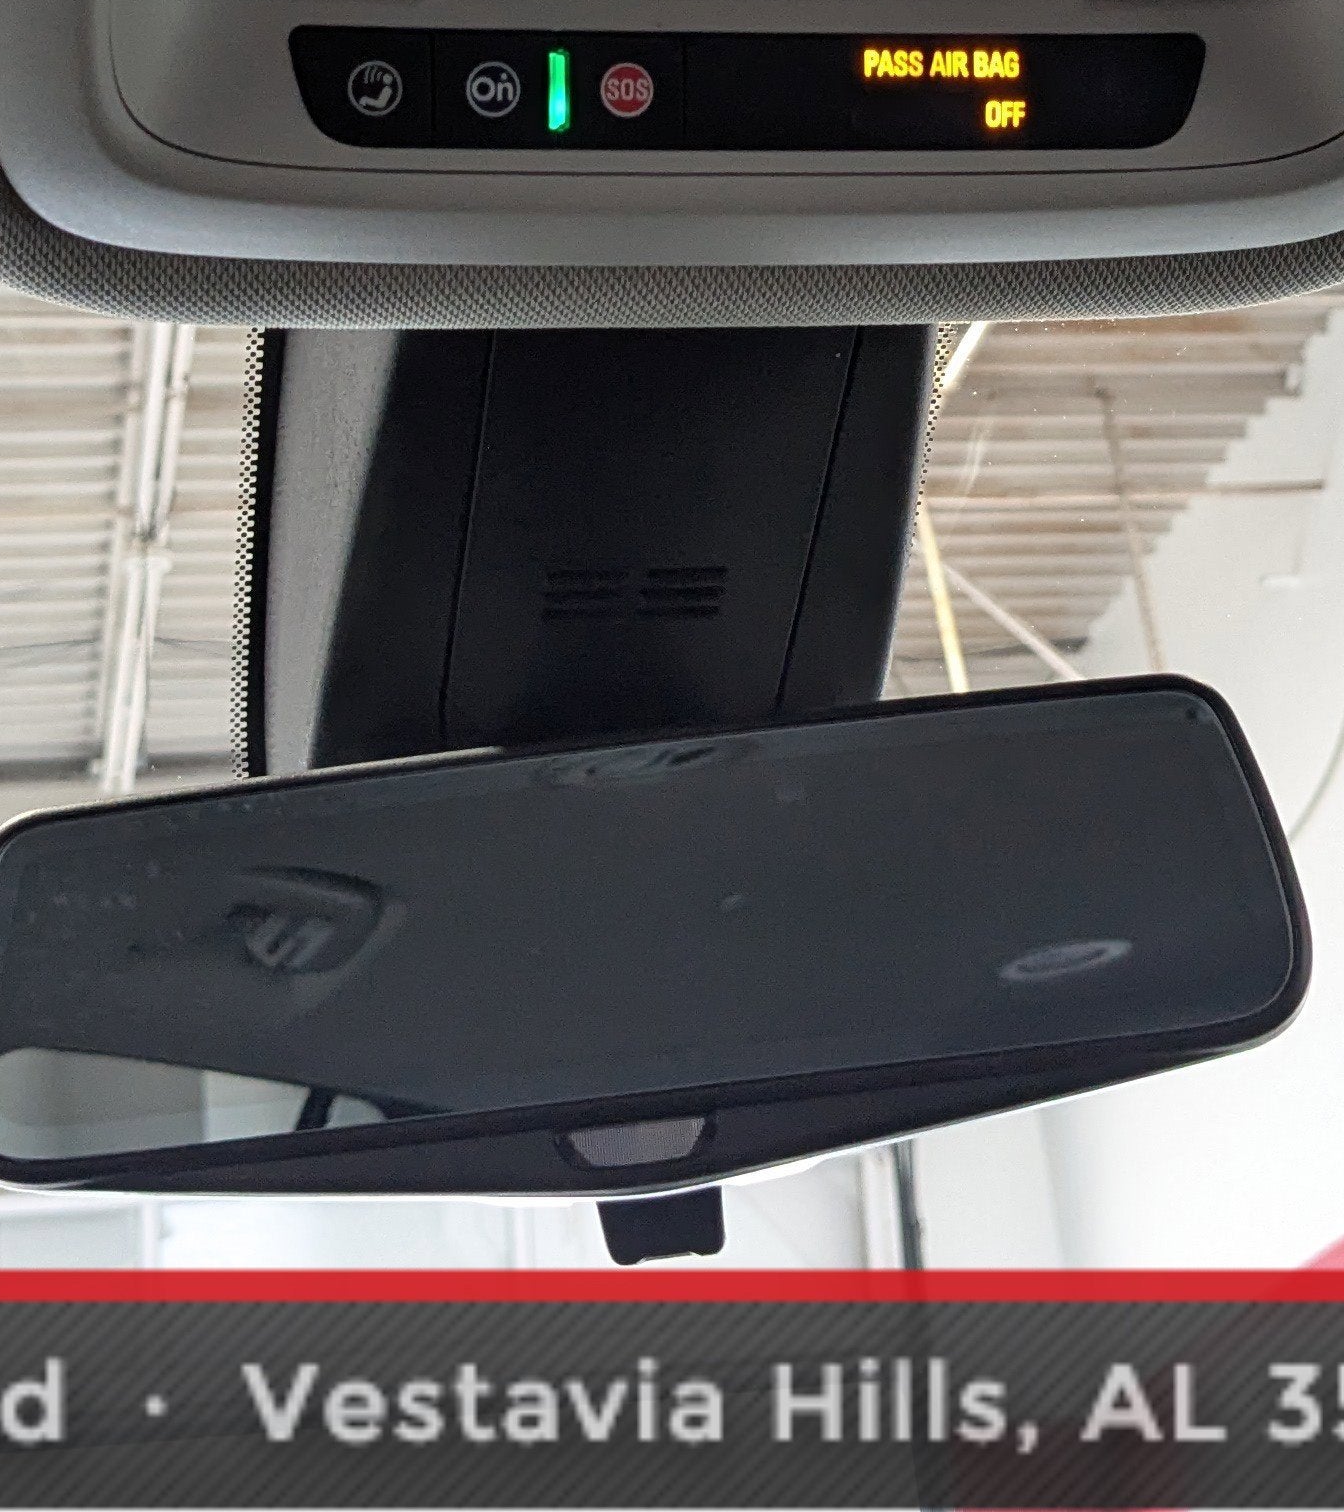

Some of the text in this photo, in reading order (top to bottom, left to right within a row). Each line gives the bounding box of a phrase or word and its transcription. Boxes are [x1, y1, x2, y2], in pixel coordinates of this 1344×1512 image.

[863, 48, 1020, 79] PASS AIR BAG
[606, 77, 651, 101] SOS
[984, 99, 1027, 129] OFF
